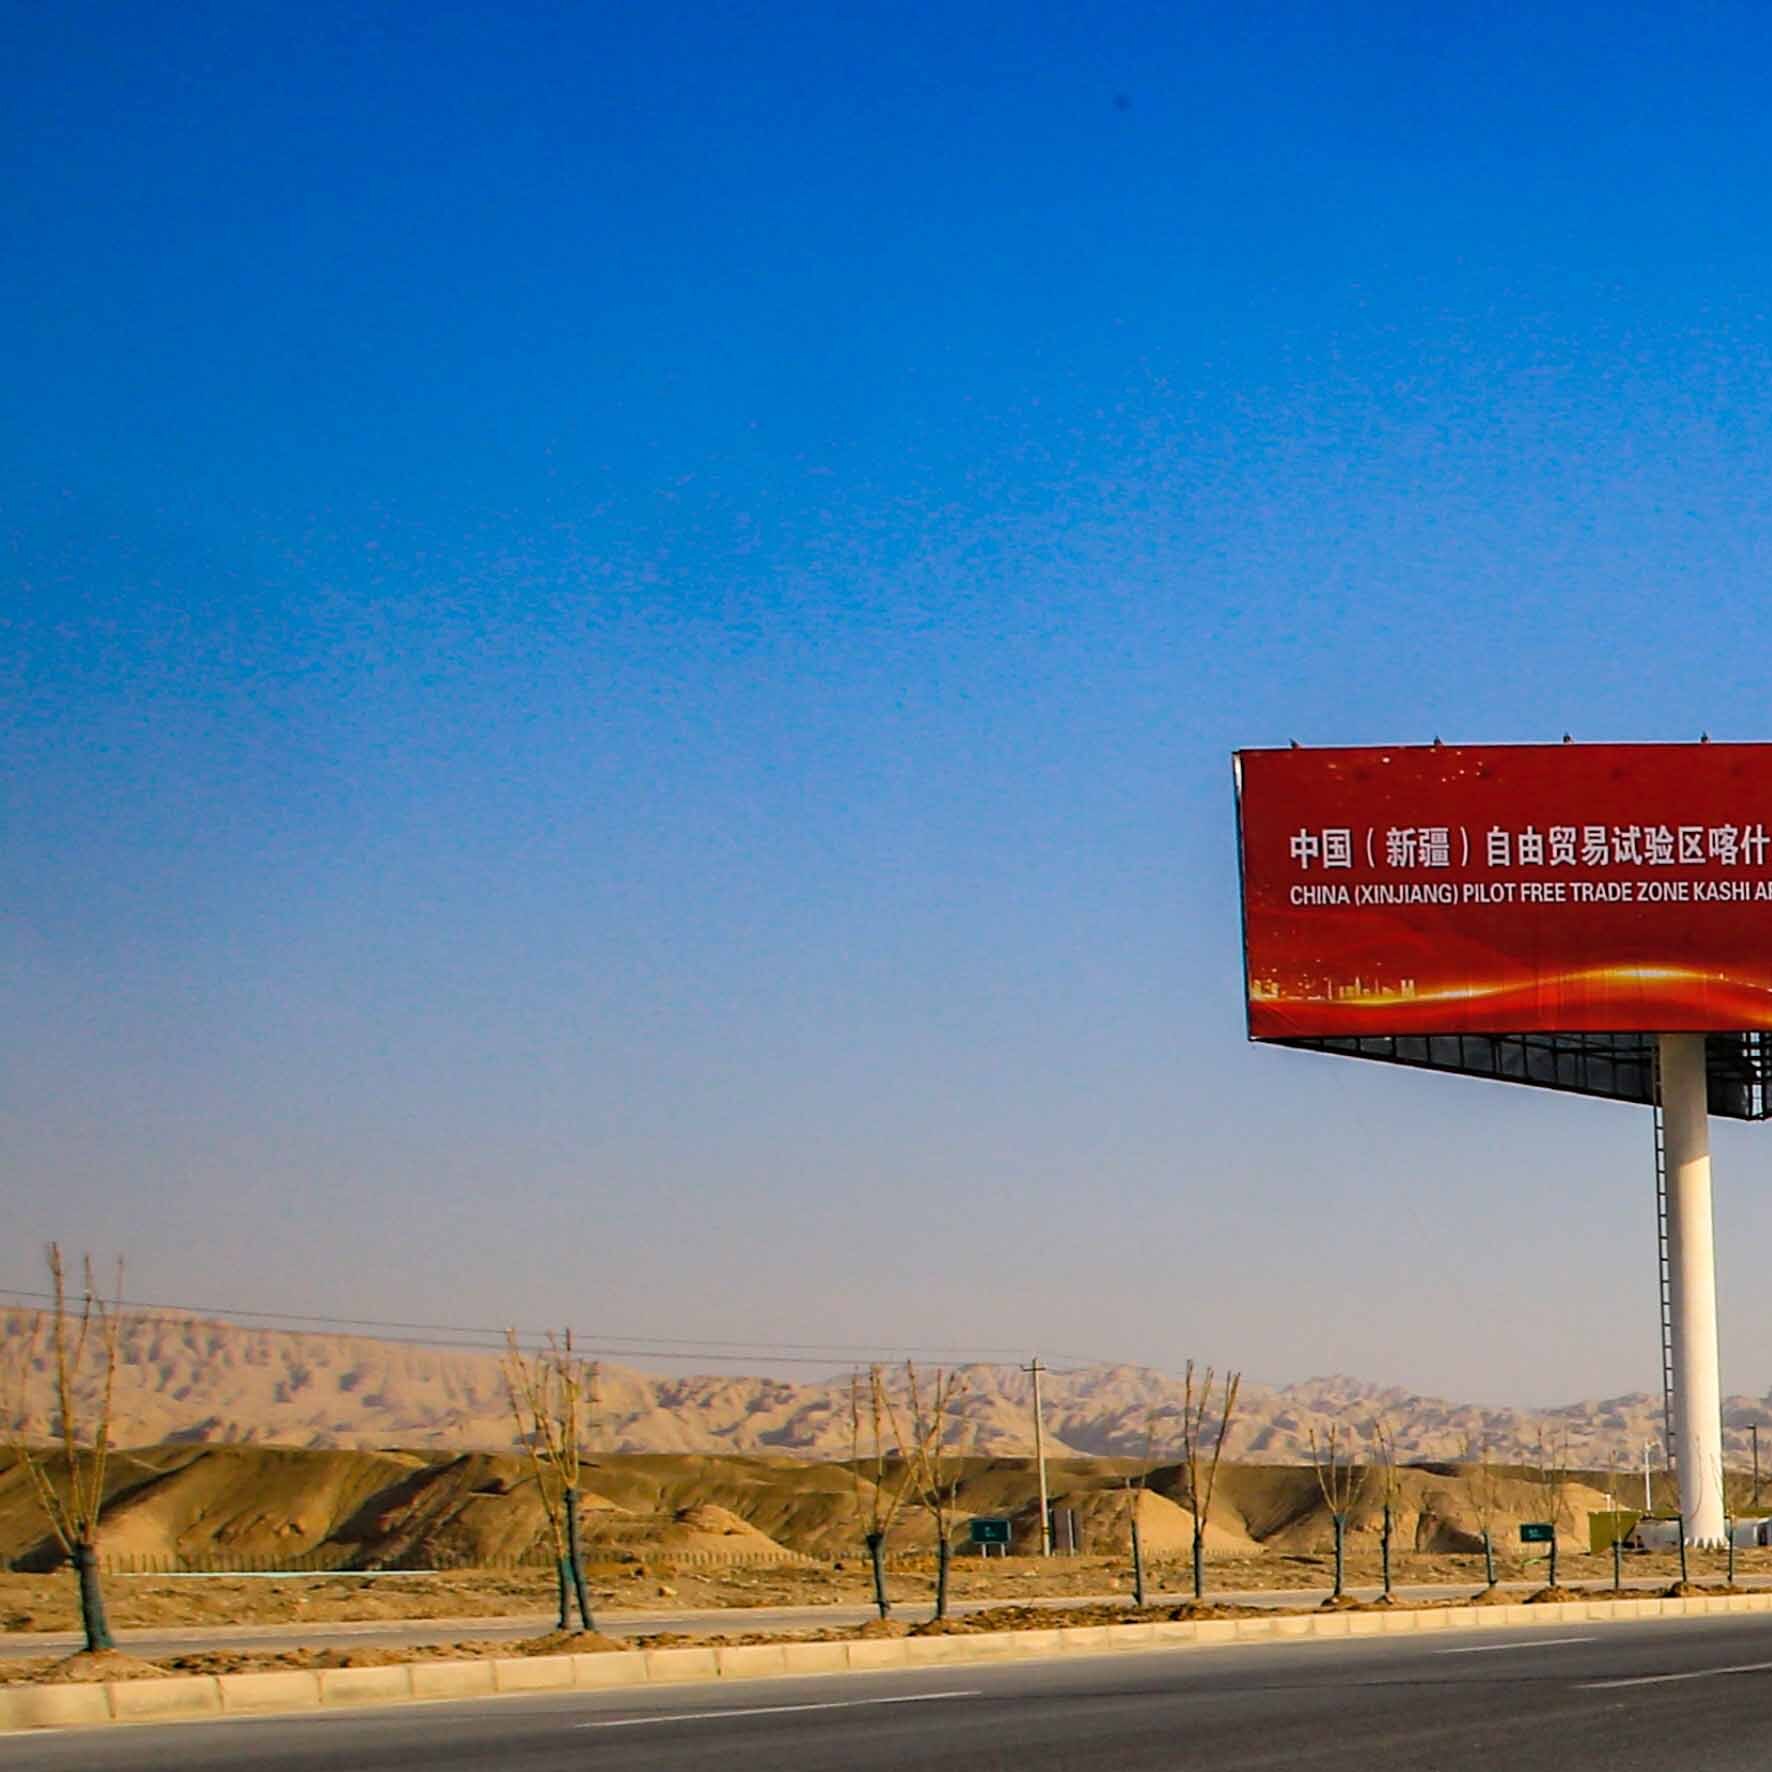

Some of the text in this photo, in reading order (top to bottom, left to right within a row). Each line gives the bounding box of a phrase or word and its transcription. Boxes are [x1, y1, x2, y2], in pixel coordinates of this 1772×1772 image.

[1290, 884, 1351, 905] CHINA
[1354, 883, 1459, 907] (XINJIANG)
[1463, 883, 1516, 903] PILOT
[1521, 882, 1566, 902] FREE
[1570, 882, 1633, 902] TRADE
[1636, 881, 1689, 901] ZONE
[1693, 881, 1750, 901] KASHI
